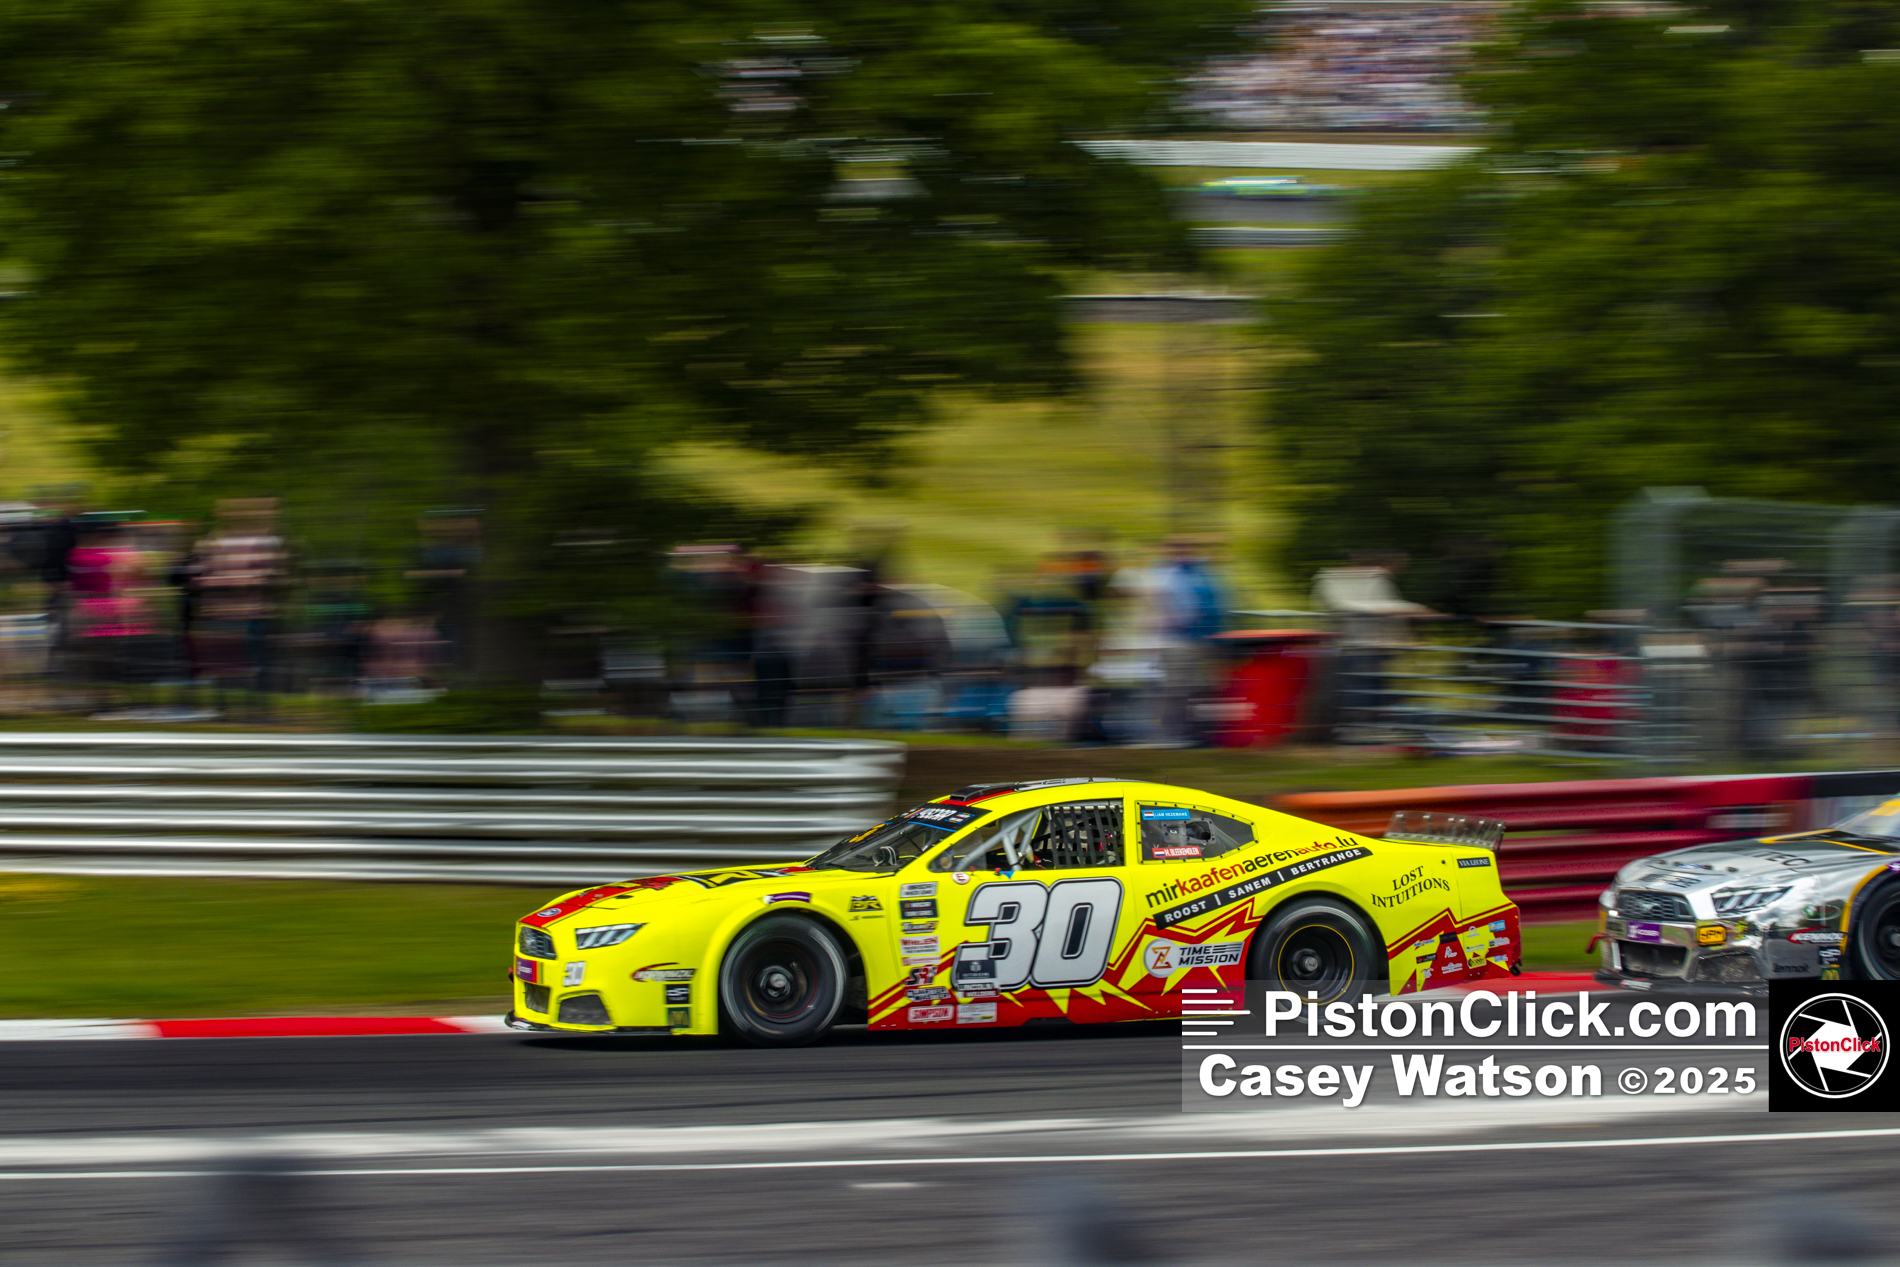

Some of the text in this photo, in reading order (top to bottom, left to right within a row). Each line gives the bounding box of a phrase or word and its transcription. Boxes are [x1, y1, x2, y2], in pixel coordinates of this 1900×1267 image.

[1145, 836, 1359, 908] mirkaafenaerenauto.lu
[1470, 858, 1490, 866] LEONE
[1164, 901, 1206, 923] ROOST
[1228, 877, 1271, 899] SANEM
[1291, 846, 1362, 876] BERTRANGE
[1392, 866, 1424, 891] LOST
[1371, 877, 1450, 908] INTUITIONS
[951, 876, 1125, 991] 30
[1178, 945, 1212, 956] TIME
[1178, 954, 1239, 966] MISSION
[912, 1007, 949, 1020] SIMPSON
